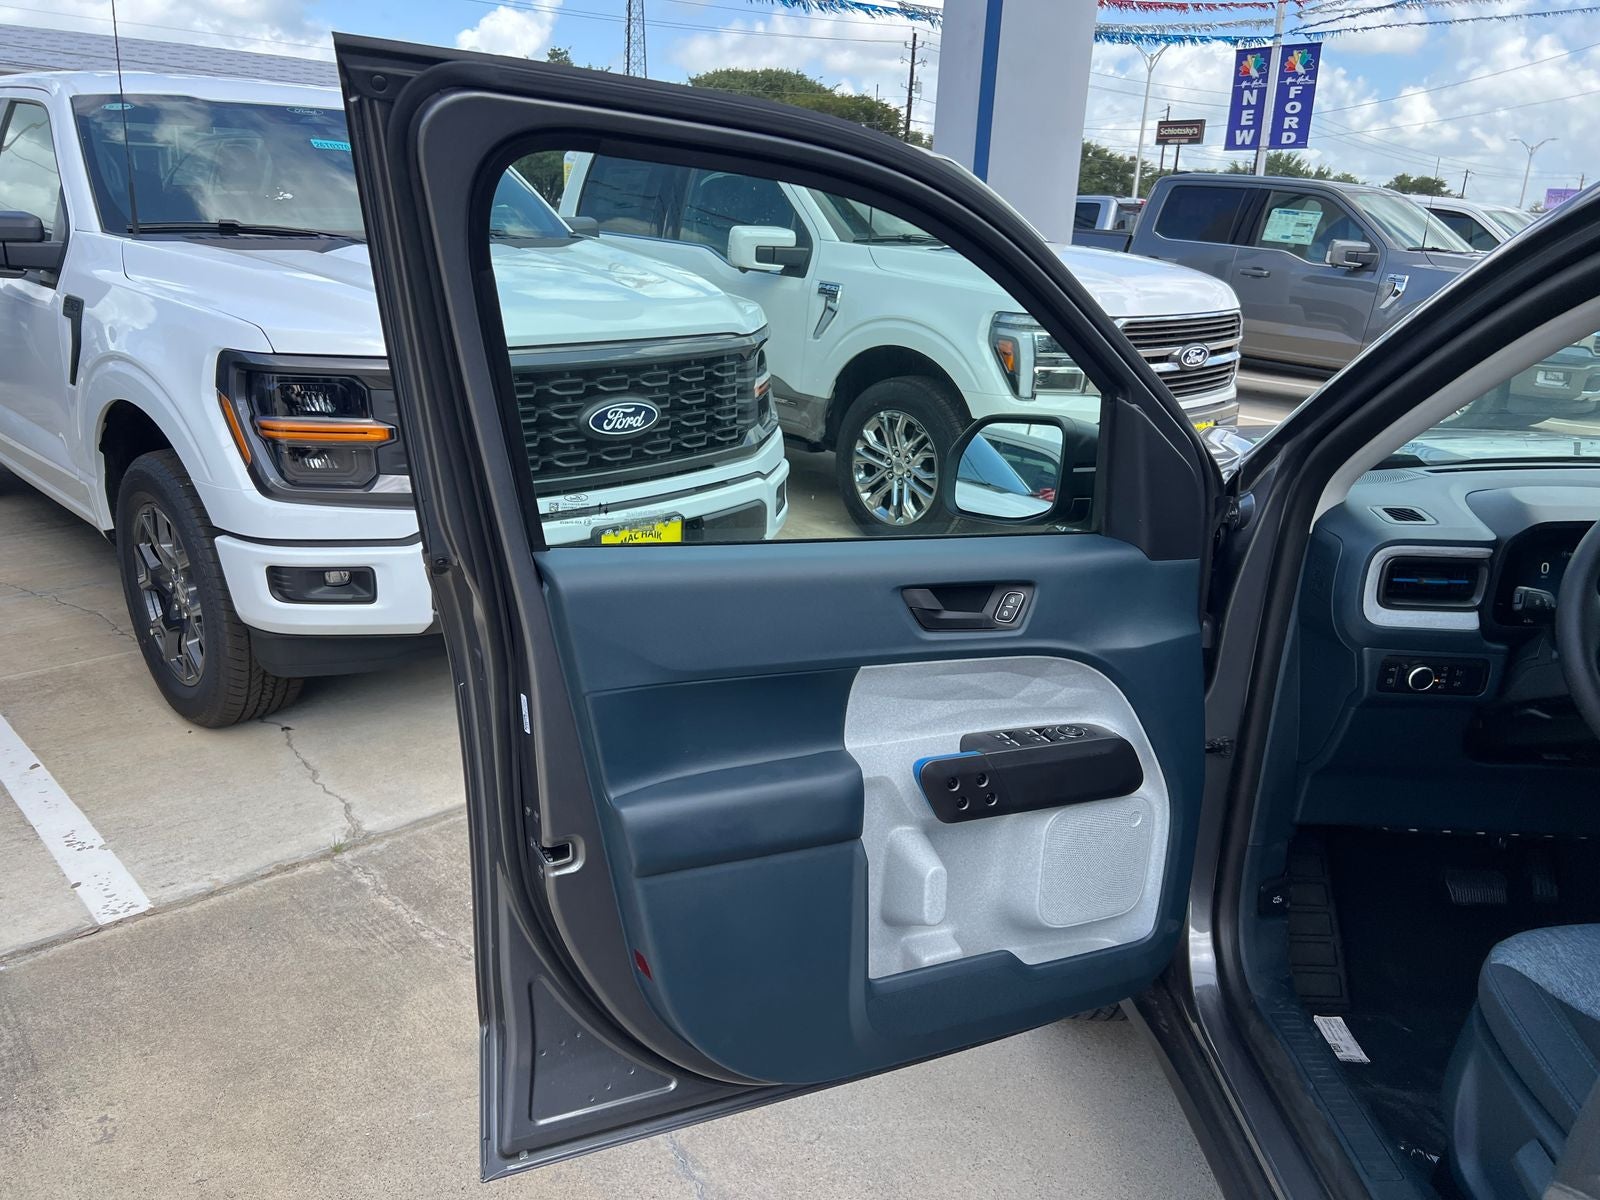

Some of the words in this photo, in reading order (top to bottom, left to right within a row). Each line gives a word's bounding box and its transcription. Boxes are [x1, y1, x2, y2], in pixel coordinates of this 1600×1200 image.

[1235, 89, 1258, 145] NEW
[1281, 86, 1303, 144] FORD
[1160, 127, 1198, 135] Schlotzsky's
[1186, 349, 1205, 364] Ford
[603, 407, 646, 431] Ford
[1541, 562, 1550, 574] 0
